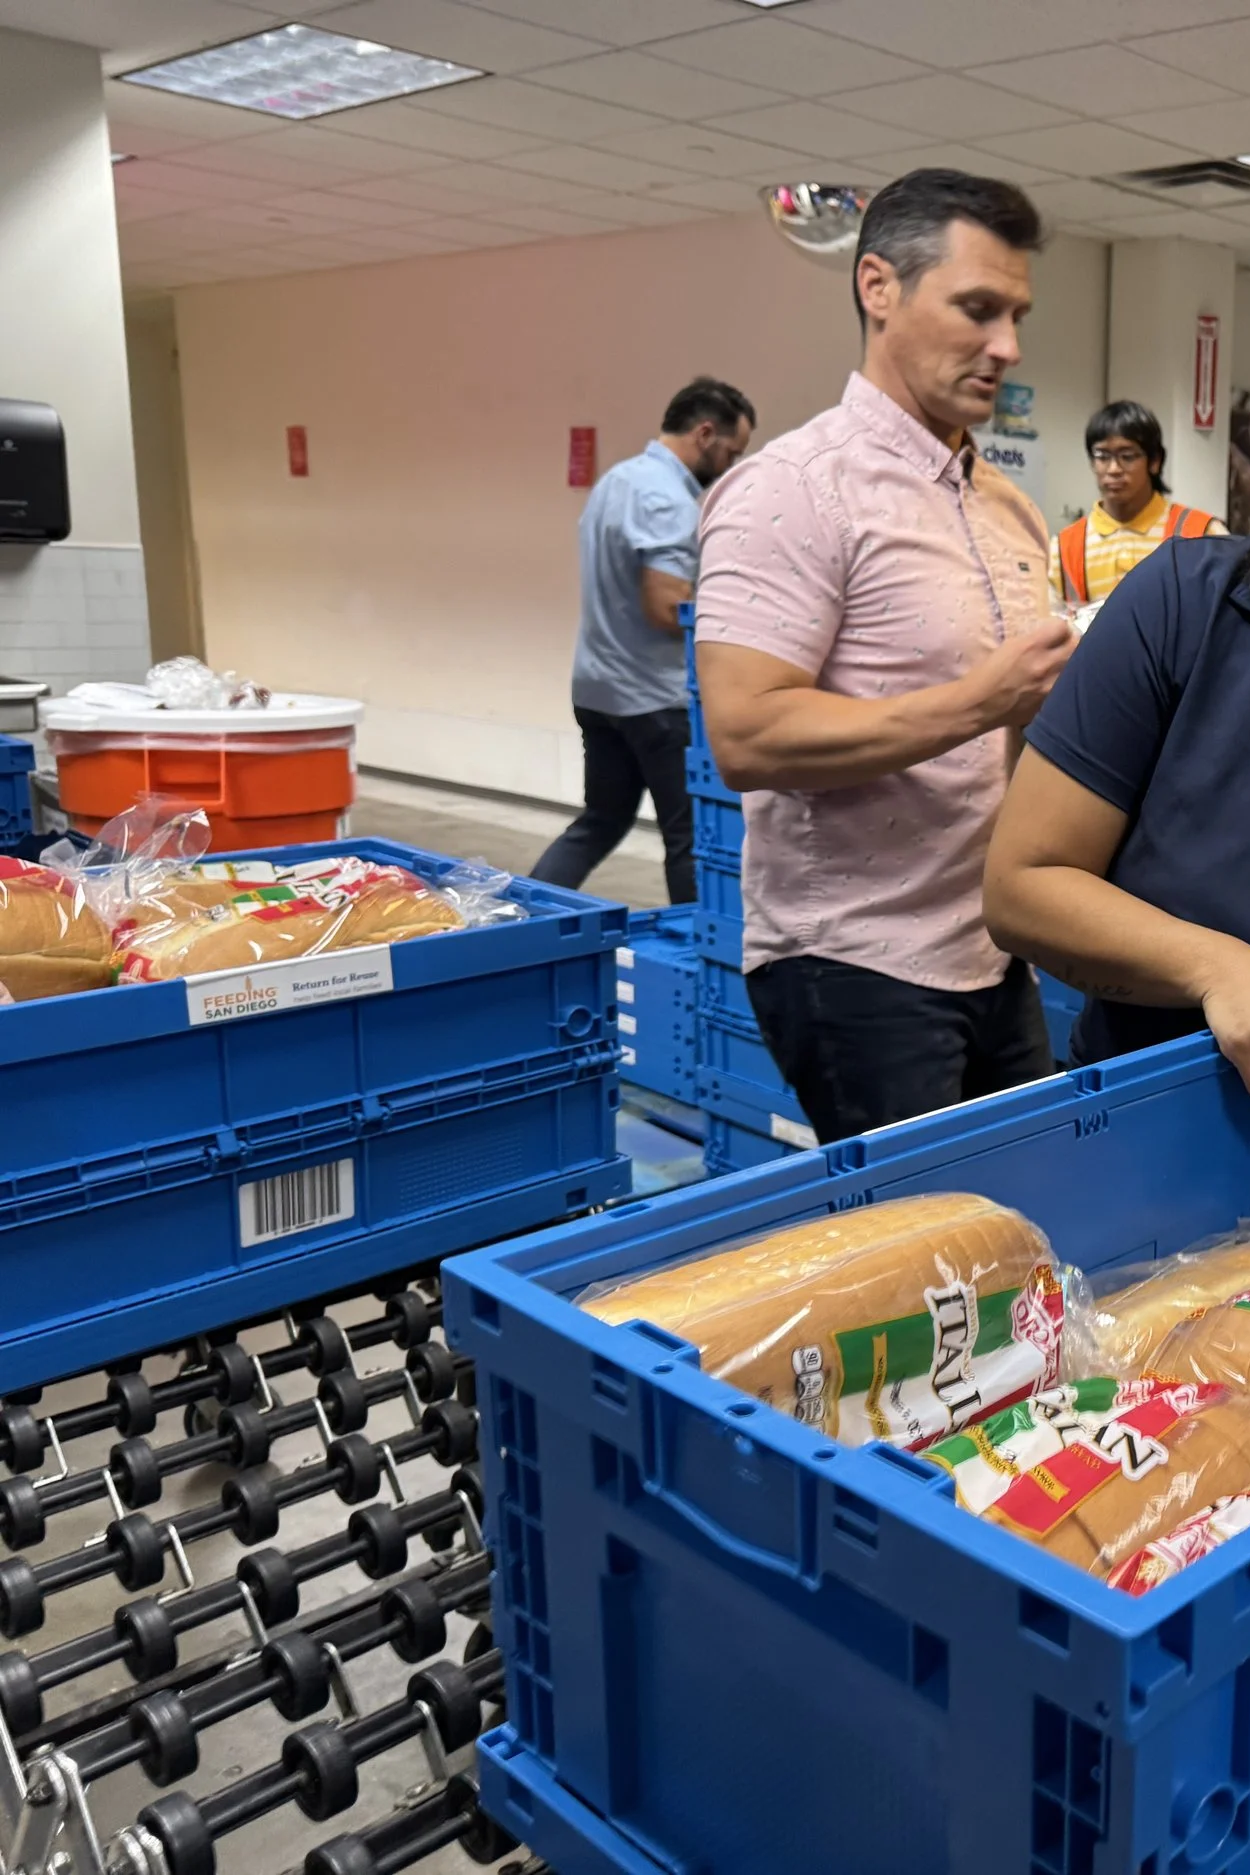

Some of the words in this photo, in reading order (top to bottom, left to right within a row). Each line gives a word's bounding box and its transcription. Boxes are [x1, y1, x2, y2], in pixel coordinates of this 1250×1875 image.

[292, 979, 330, 993] Return
[331, 975, 348, 986] for
[349, 970, 379, 982] Reuse
[203, 984, 278, 1009] FEEDING
[205, 1005, 233, 1020] SAN
[236, 998, 278, 1015] DIEGO
